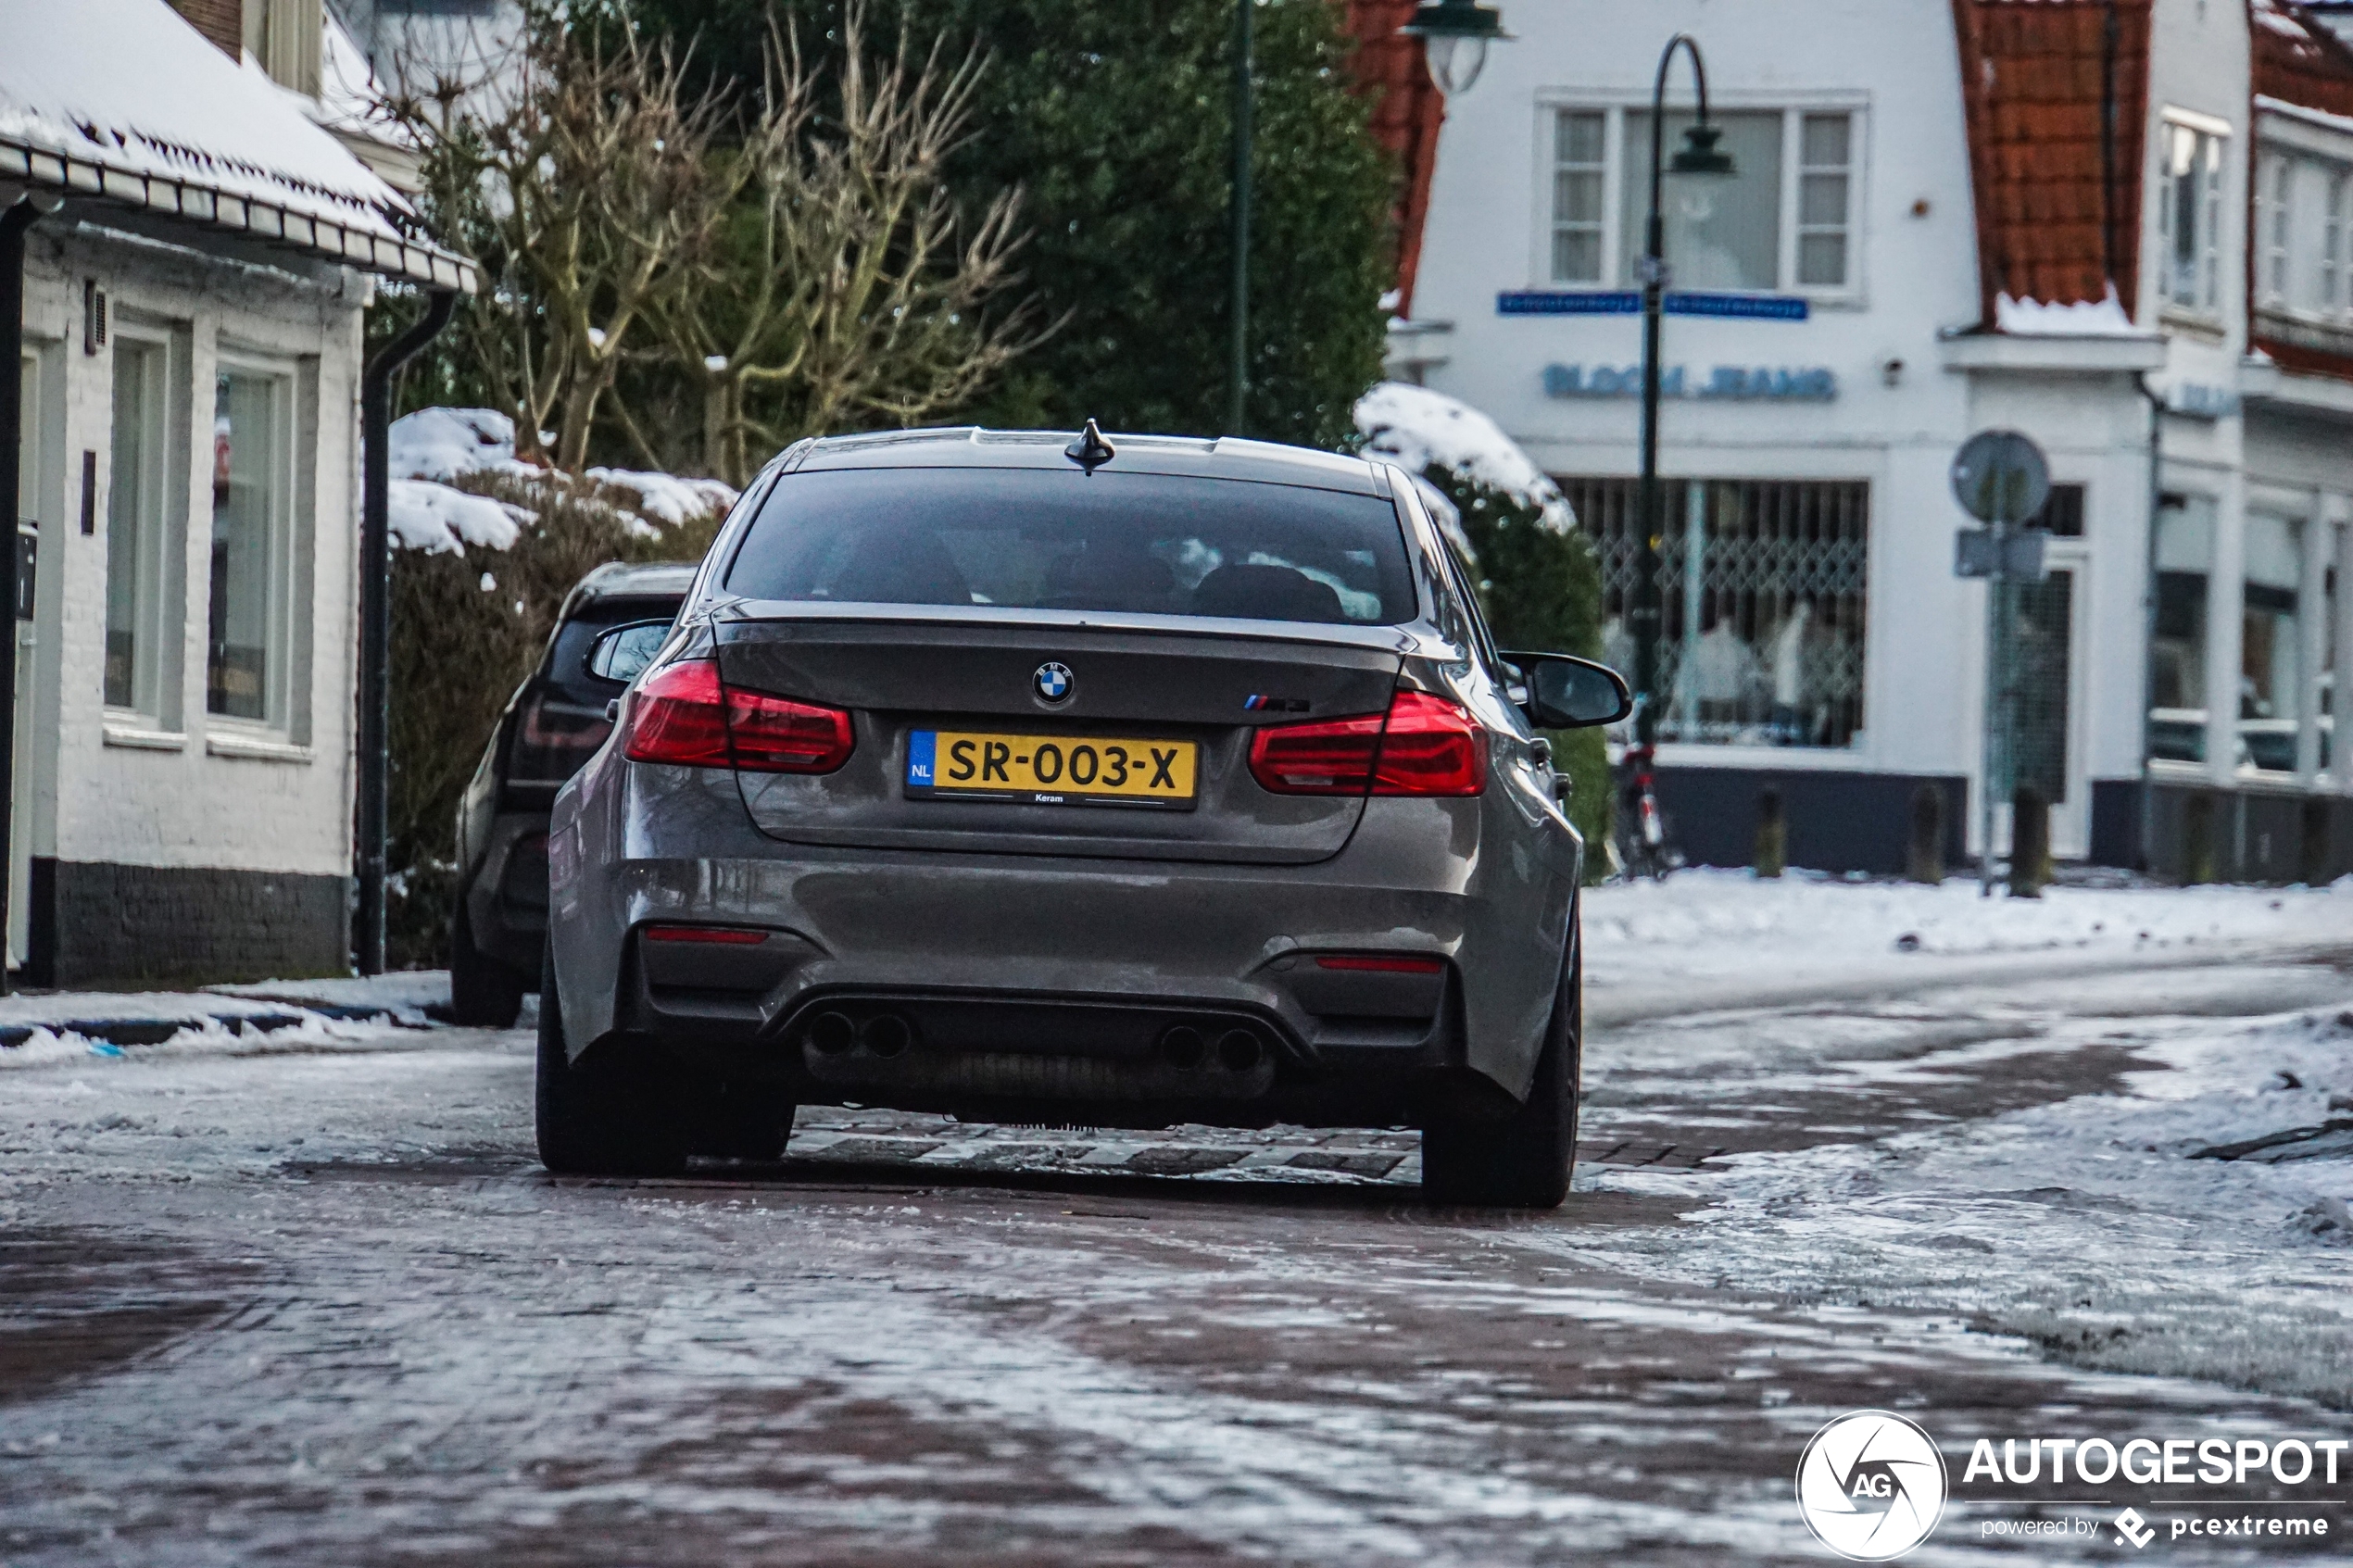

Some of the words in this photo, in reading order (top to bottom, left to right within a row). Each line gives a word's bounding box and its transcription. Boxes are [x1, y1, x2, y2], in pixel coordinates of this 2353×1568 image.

[1036, 663, 1072, 677] BMW
[912, 764, 931, 778] NL
[948, 739, 1178, 789] SR-003-X
[1035, 793, 1063, 803] Keram
